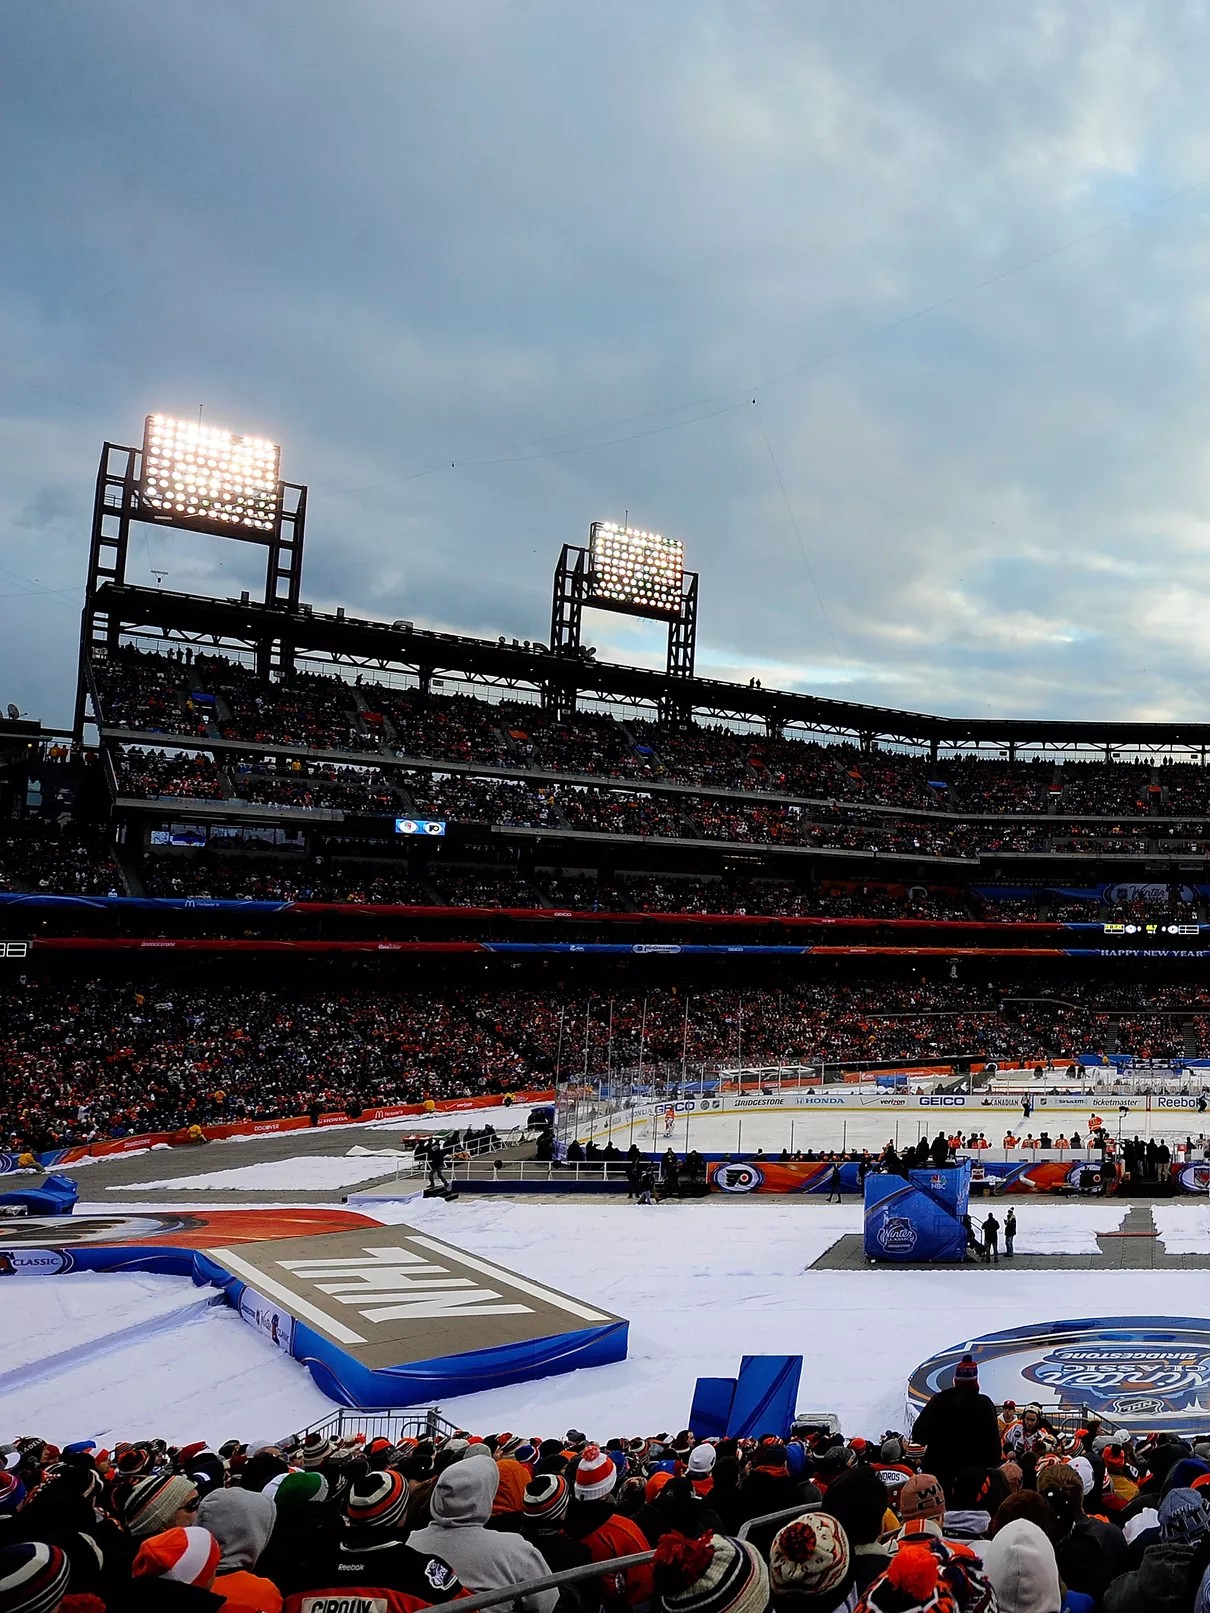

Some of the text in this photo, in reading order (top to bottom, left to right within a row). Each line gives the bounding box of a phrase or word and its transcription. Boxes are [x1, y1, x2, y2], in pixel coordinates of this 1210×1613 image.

[734, 1099, 784, 1107] BRIDGESTONE
[880, 1098, 905, 1106] verizon
[919, 1096, 965, 1106] GEICO
[990, 1098, 1019, 1106] CANADIAN
[1092, 1098, 1138, 1106] ticketmaster
[884, 1225, 913, 1239] Winter
[12, 1257, 59, 1267] CLASSIC
[1060, 1352, 1198, 1361] BRIDGESTONE
[1063, 1364, 1206, 1373] CLASSIC
[1120, 1400, 1154, 1413] NHL
[337, 1563, 365, 1572] Reebok
